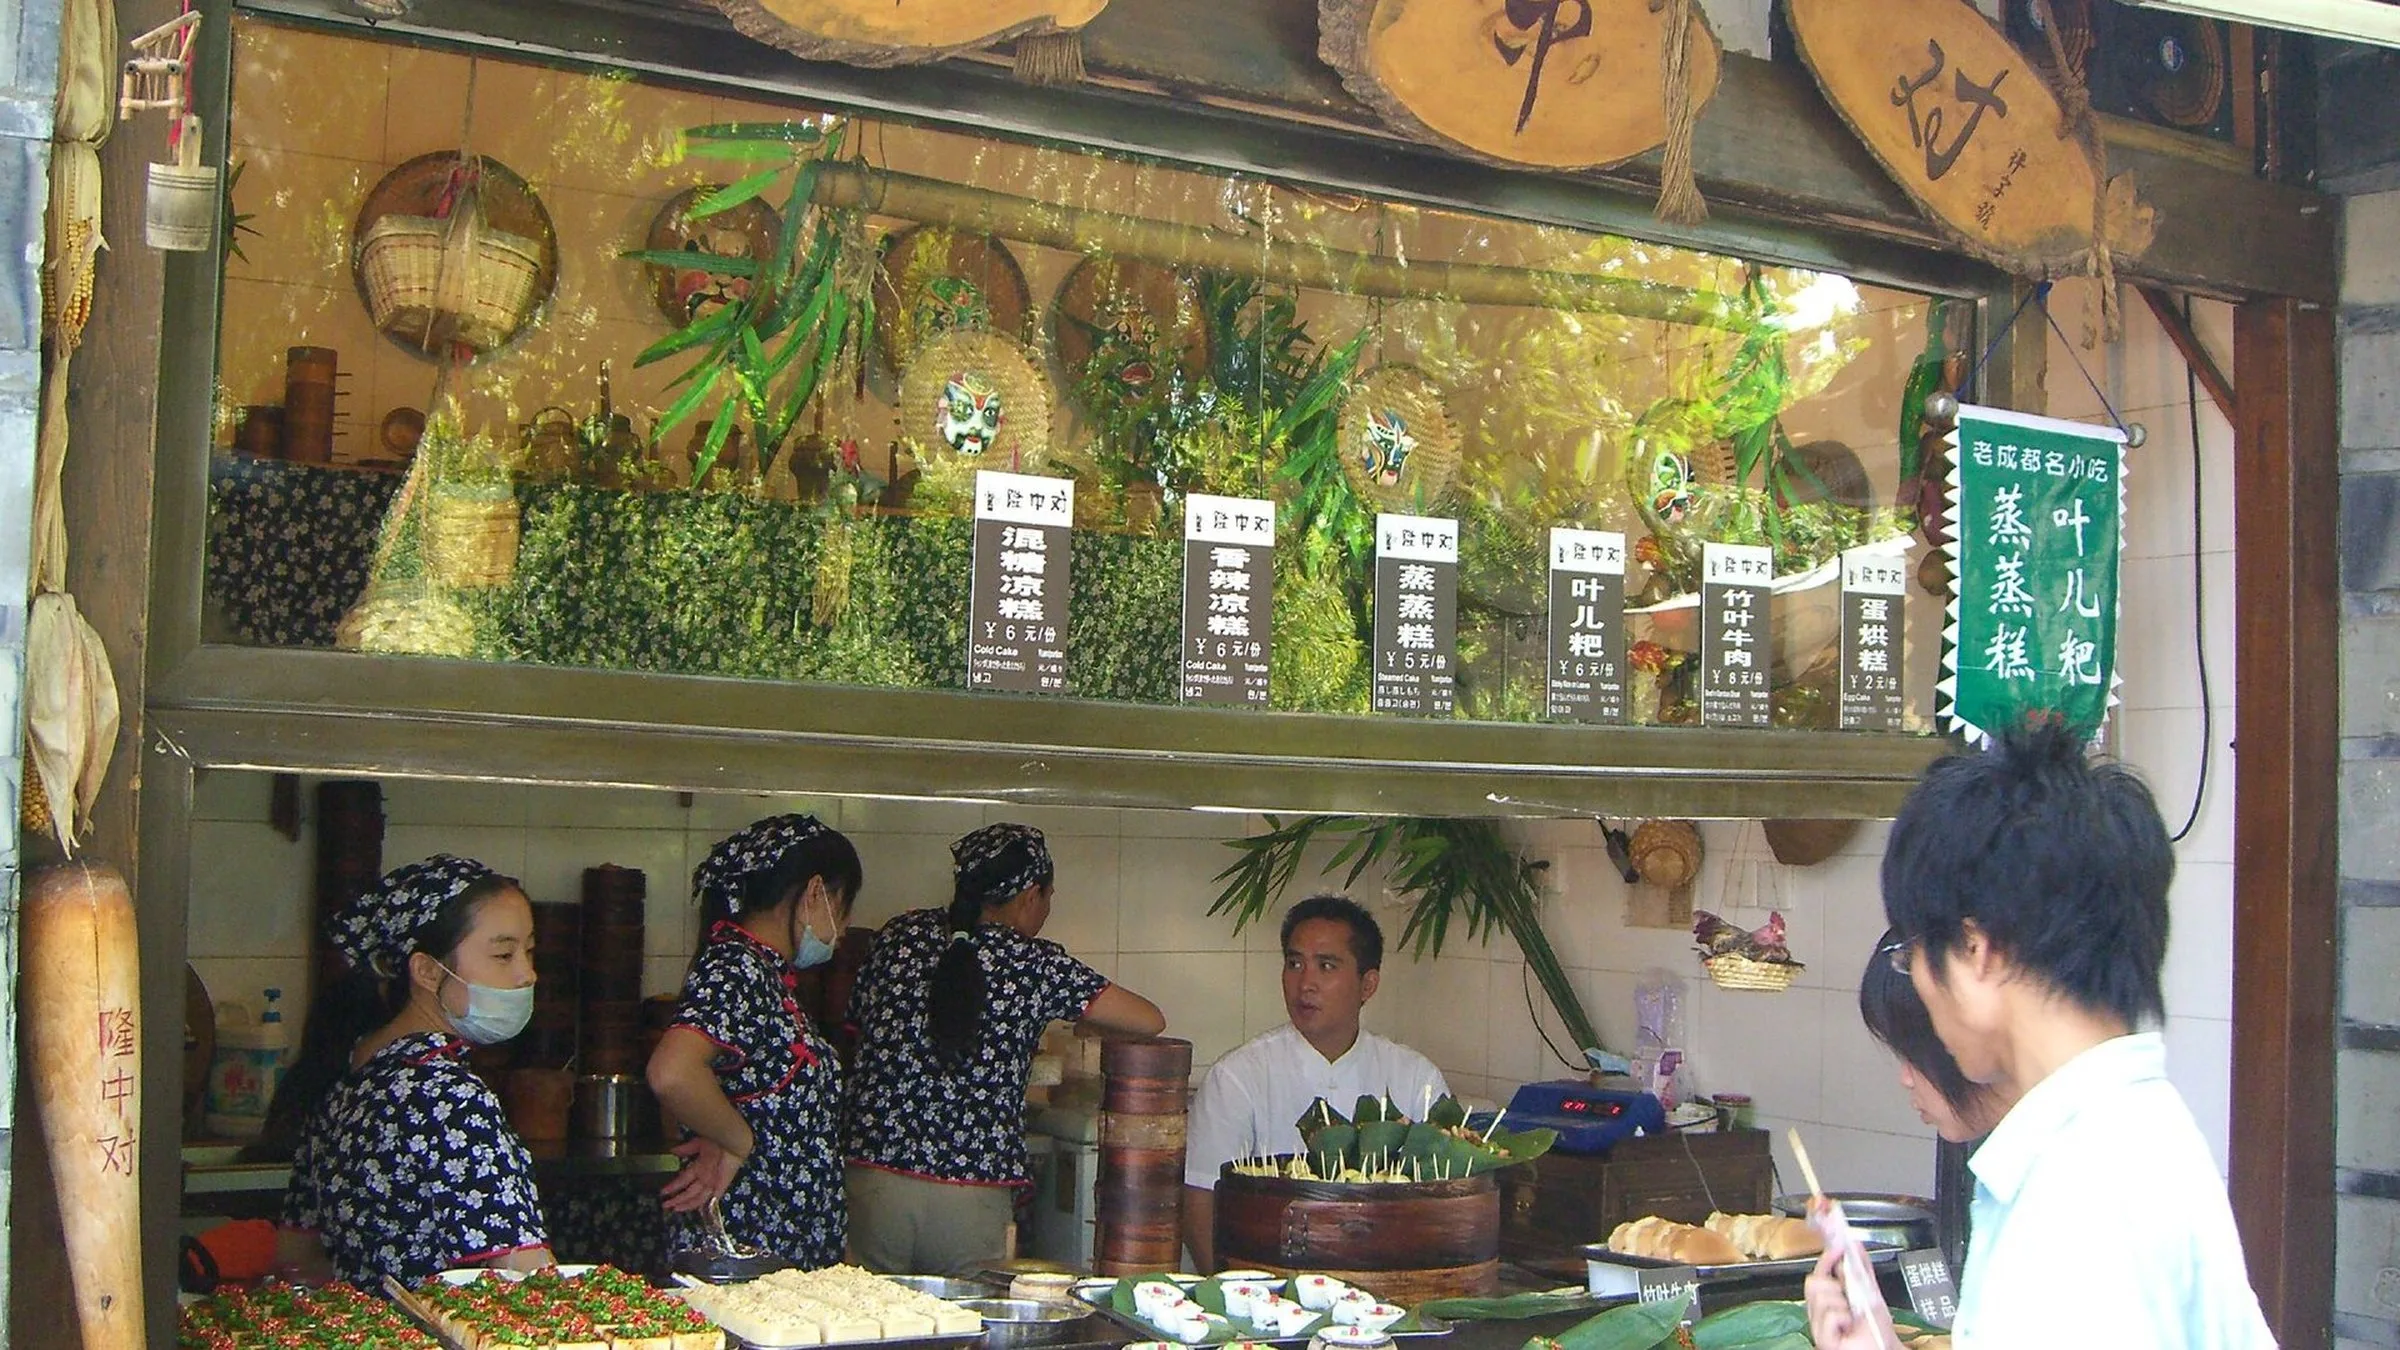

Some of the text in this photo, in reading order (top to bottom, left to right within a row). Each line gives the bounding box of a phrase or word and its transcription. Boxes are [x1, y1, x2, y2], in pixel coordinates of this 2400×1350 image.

[1973, 440, 2109, 483] 老成都名小吃
[1208, 547, 1250, 636] 香辣凉糕
[1985, 482, 2036, 682] 蒸蒸糕
[2053, 498, 2102, 687] 叶儿粑
[1397, 564, 1435, 649] 蒸蒸糕
[1569, 578, 1605, 657] 叶儿粑
[1006, 624, 1016, 640] 6
[1024, 625, 1056, 643] 元/份
[1721, 589, 1755, 667] 竹叶牛肉
[1858, 598, 1889, 671] 蛋烘糕
[974, 643, 1018, 657] Cold Cake
[1217, 642, 1226, 657] 6
[1232, 641, 1261, 657] 元/份
[1405, 652, 1414, 669] 5
[1420, 654, 1446, 669] 元/份
[1186, 660, 1226, 671] Cold Cake
[1576, 663, 1584, 677] 6
[1589, 662, 1614, 677] 元/份
[1729, 672, 1736, 684] 8
[1865, 675, 1873, 689] 2
[97, 1007, 136, 1177] 隆中对
[1905, 1260, 1950, 1288] 蛋烘糕
[1921, 1295, 1957, 1321] 样品
